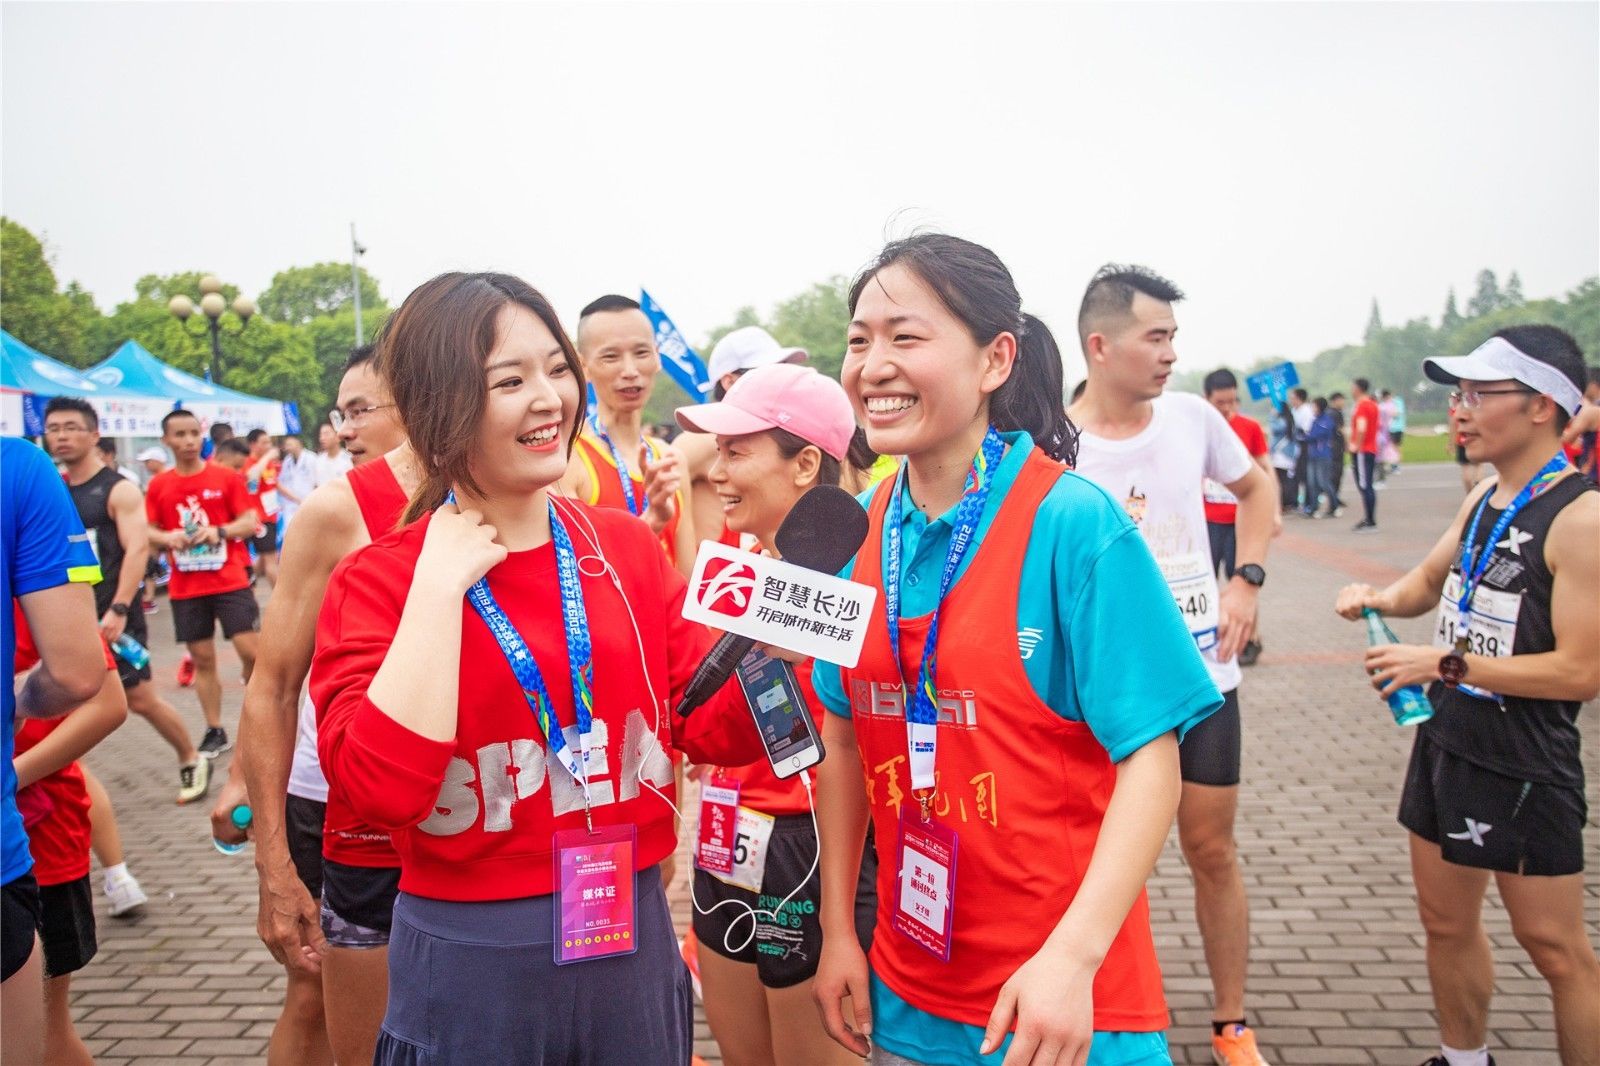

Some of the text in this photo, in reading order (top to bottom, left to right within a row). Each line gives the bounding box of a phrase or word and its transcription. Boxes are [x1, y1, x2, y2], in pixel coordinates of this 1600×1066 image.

[560, 548, 581, 636] 2019湘江马拉松赛
[763, 576, 861, 622] 智慧长沙
[472, 581, 527, 660] 2019湘江马拉松赛
[755, 605, 854, 642] 开启城市新生活
[1438, 615, 1498, 657] A1639
[582, 885, 617, 901] 媒体证
[758, 894, 815, 914] RUNNING
